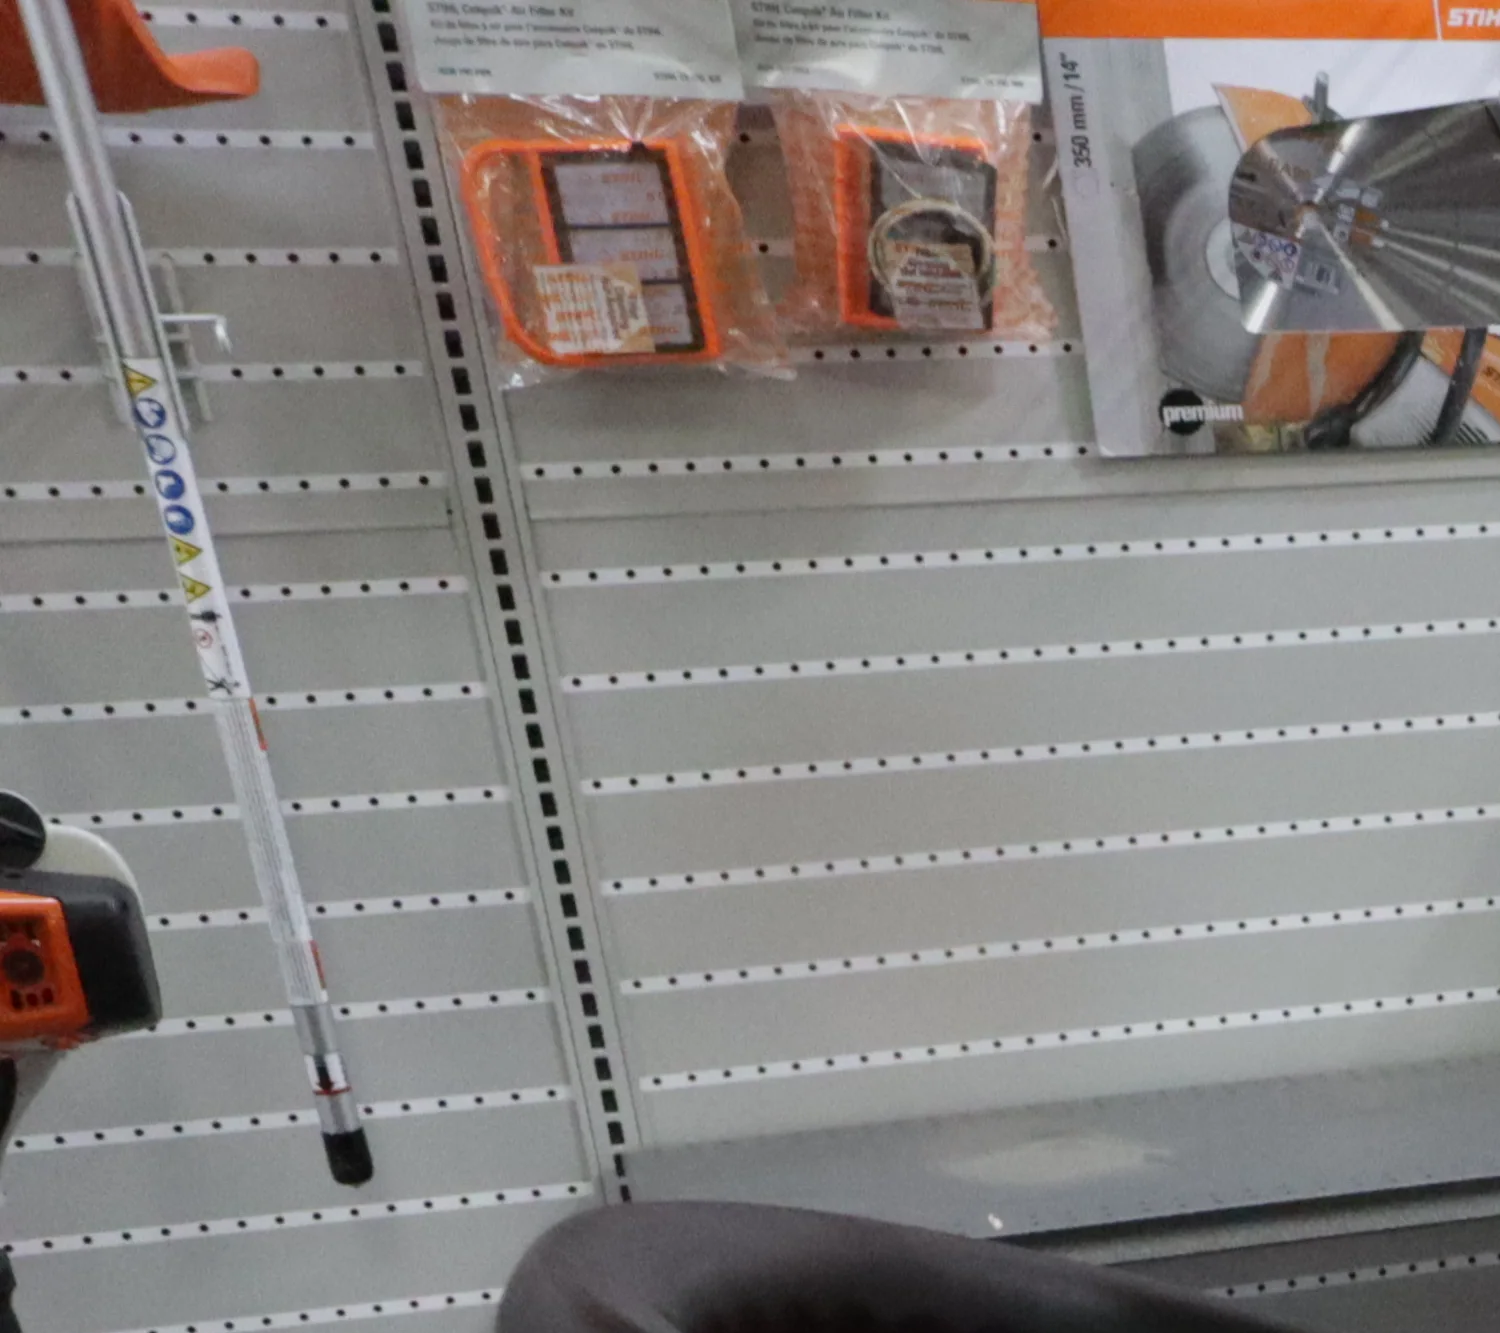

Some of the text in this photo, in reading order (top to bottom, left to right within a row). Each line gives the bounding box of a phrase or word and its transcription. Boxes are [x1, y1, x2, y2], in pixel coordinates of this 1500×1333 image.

[1070, 95, 1087, 130] mm
[1071, 135, 1092, 168] 350
[1162, 402, 1244, 428] premium
